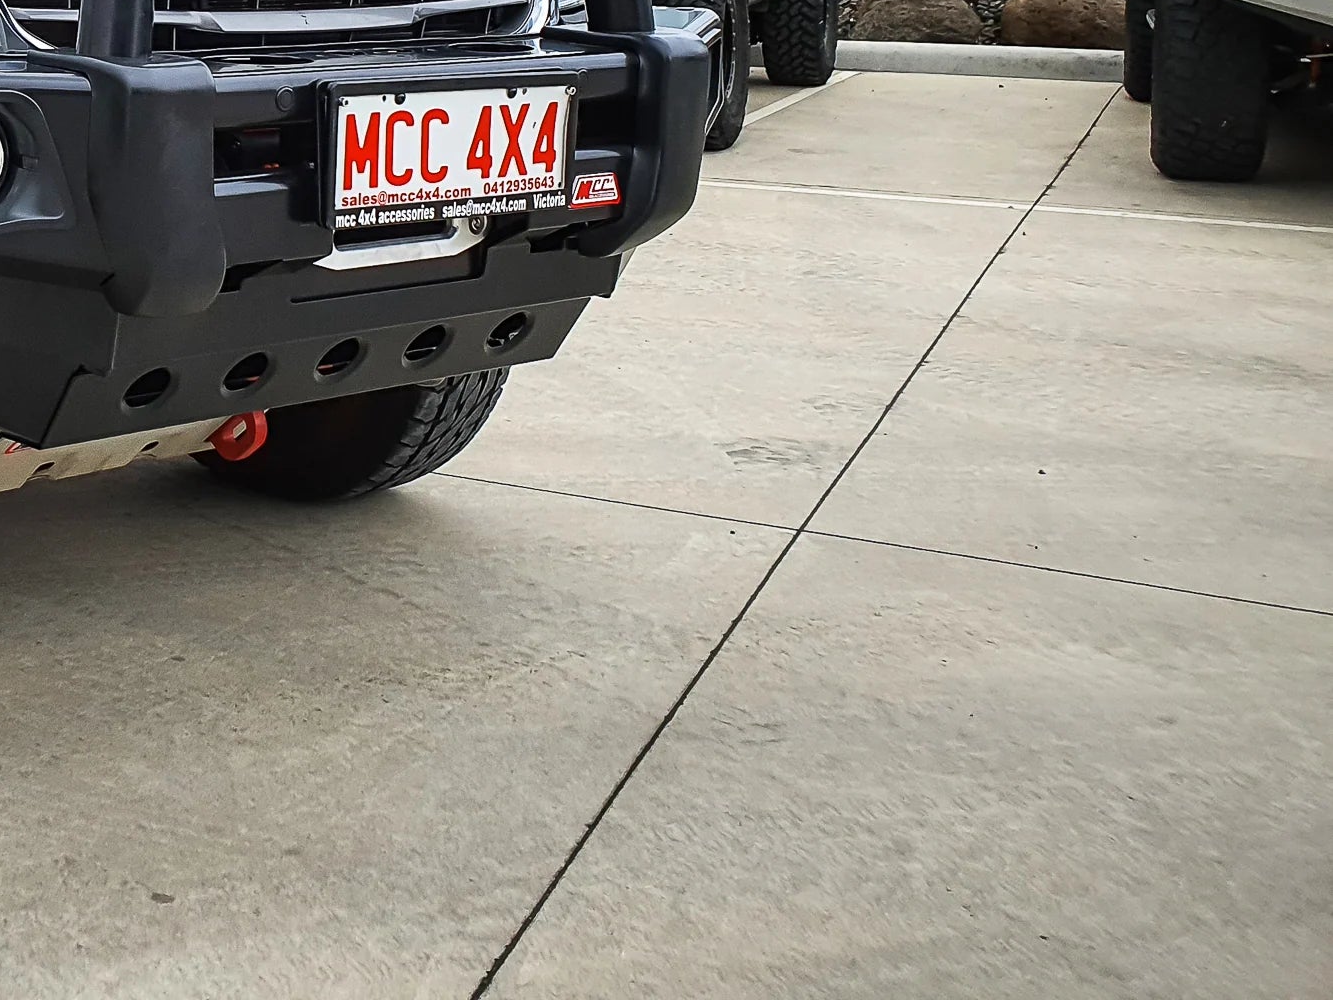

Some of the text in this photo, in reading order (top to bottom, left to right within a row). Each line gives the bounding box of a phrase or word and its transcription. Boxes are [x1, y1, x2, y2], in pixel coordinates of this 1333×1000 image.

[343, 101, 558, 190] MCC 4X4
[335, 190, 565, 228] mcc 4x4 accessories sales@mcc4x4.com Victoria
[341, 176, 555, 207] sales@mcc4x4.com 0412935643
